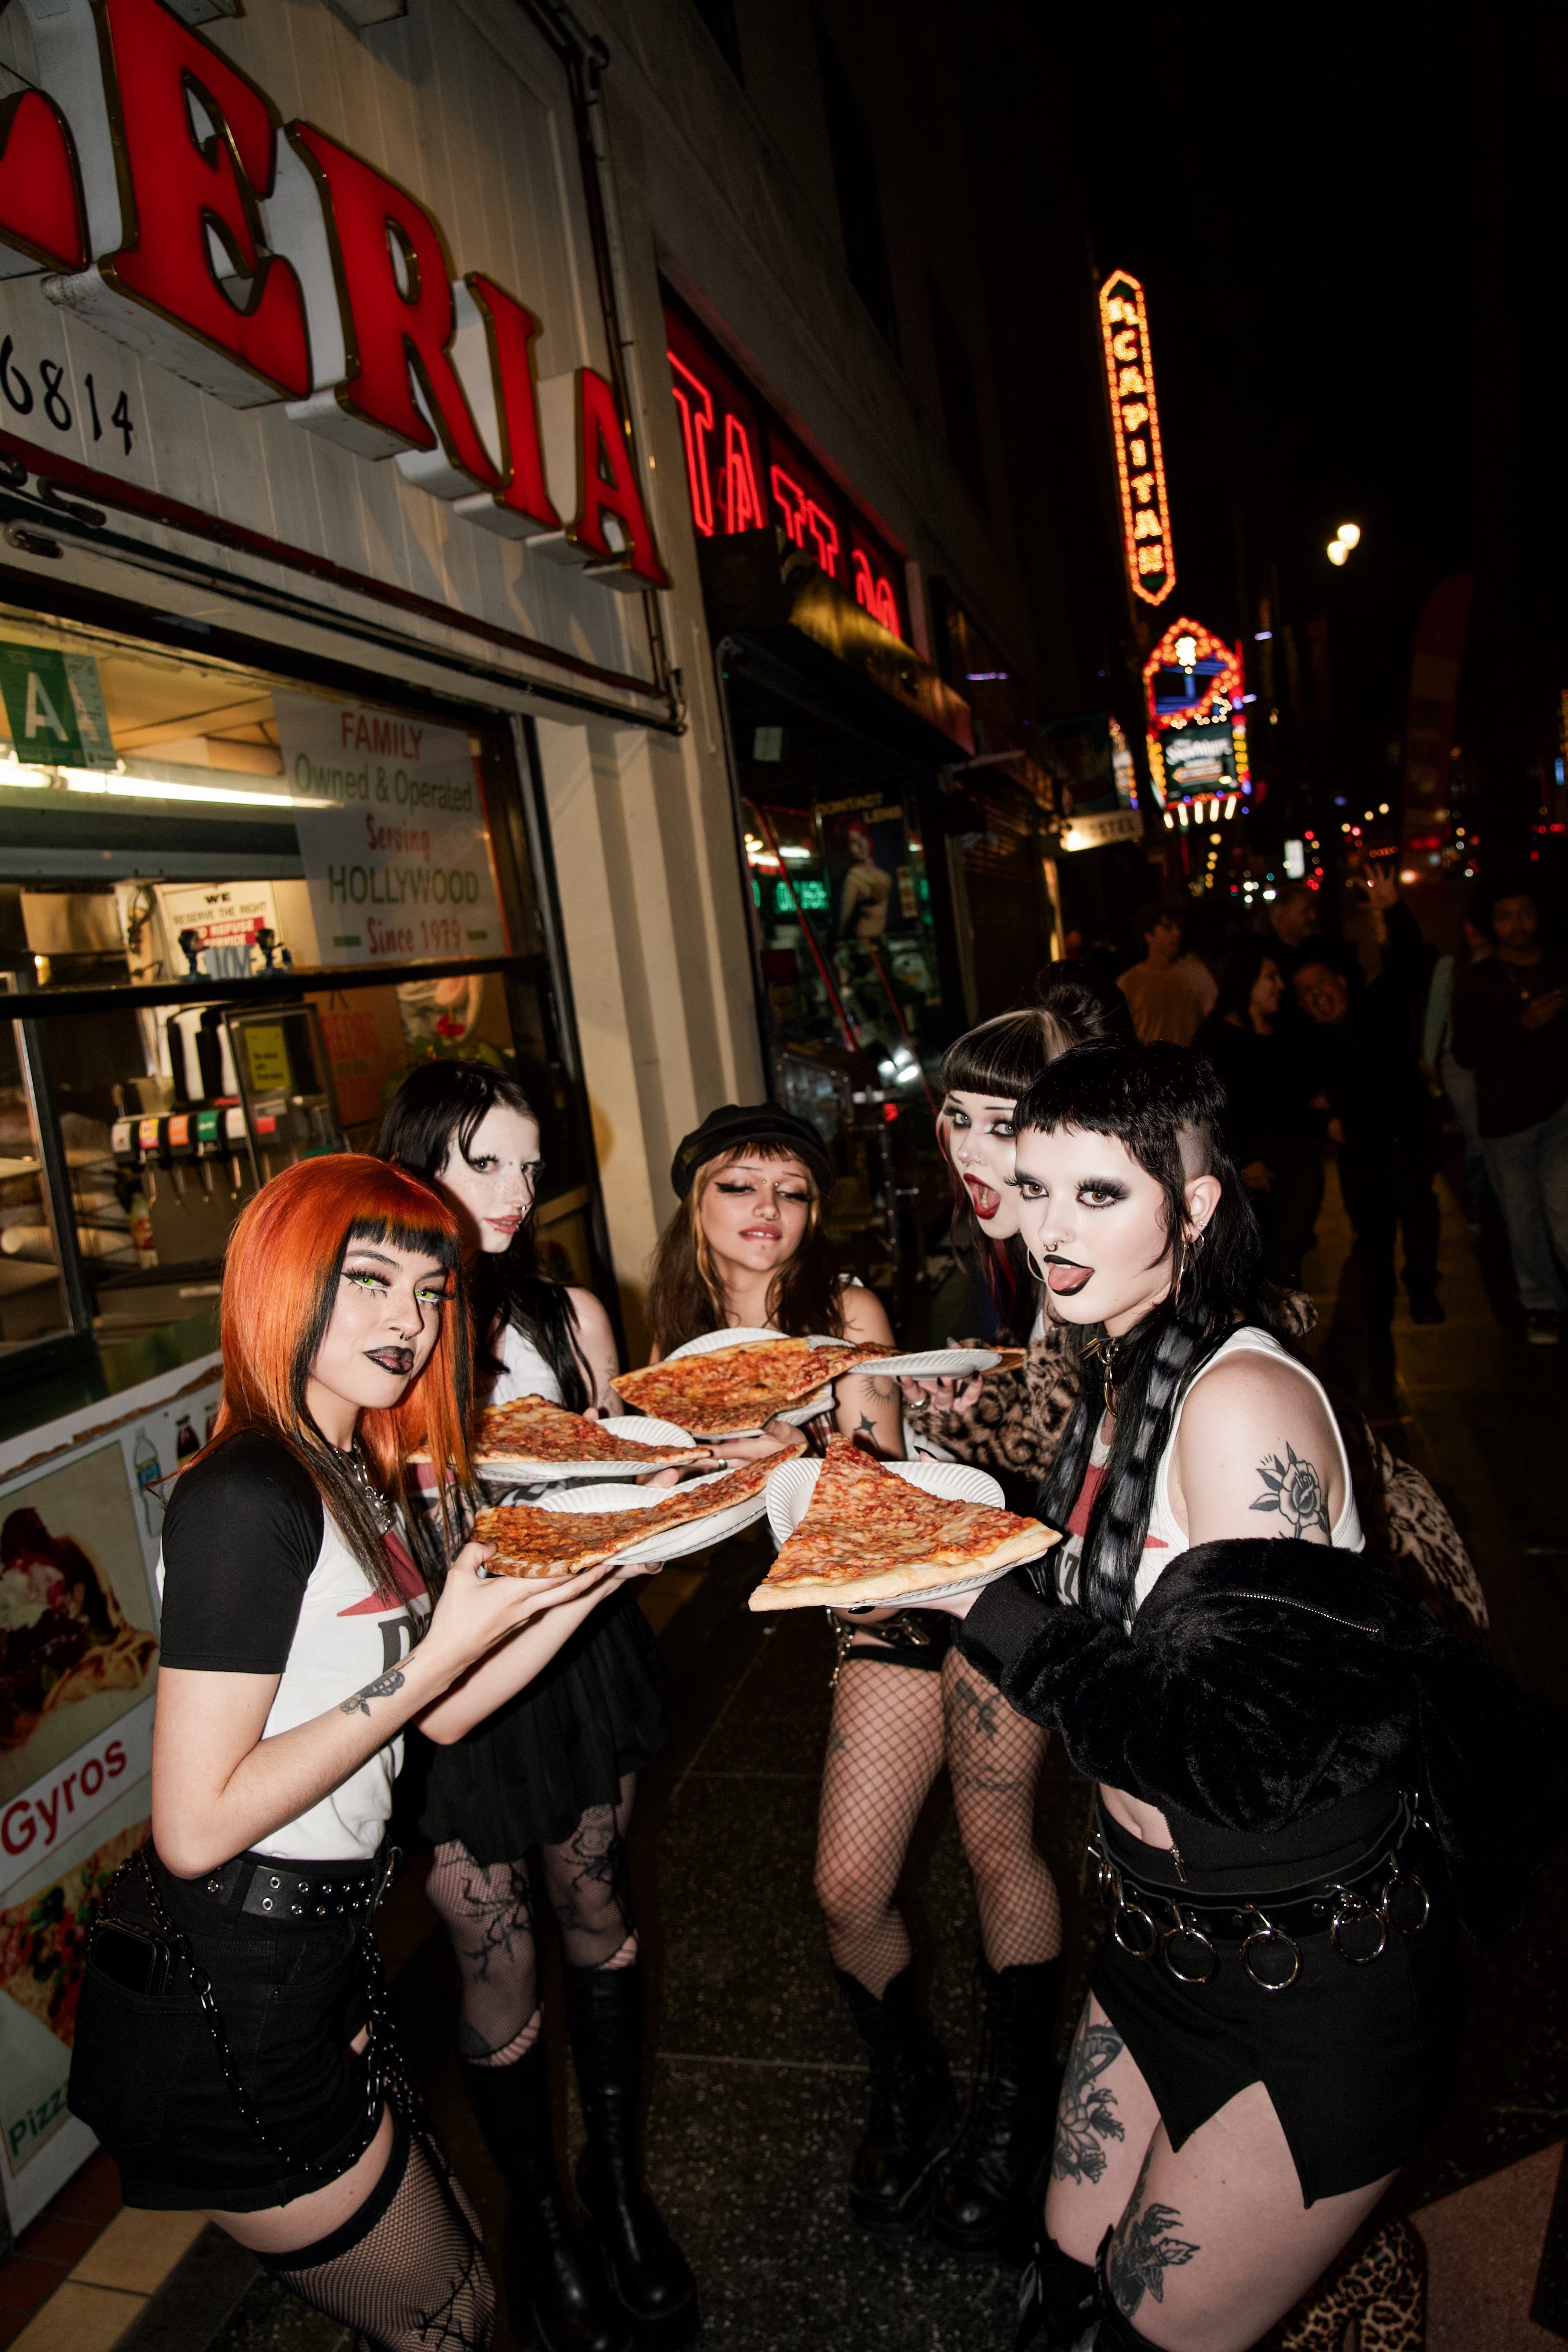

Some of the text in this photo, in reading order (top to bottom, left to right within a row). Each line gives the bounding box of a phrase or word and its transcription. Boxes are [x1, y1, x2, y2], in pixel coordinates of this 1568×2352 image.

[0, 0, 673, 589] ERIA
[0, 334, 133, 456] 6814
[24, 672, 69, 742] A
[341, 711, 423, 761] FAMILY
[294, 753, 472, 813] Owned & Operated
[366, 813, 430, 861] Serving
[205, 892, 231, 904] WE
[327, 865, 479, 904] HOLLYWOOD
[367, 917, 462, 955] Since 1979
[1, 1740, 127, 1856] Gyros
[8, 2076, 69, 2157] Pizz
